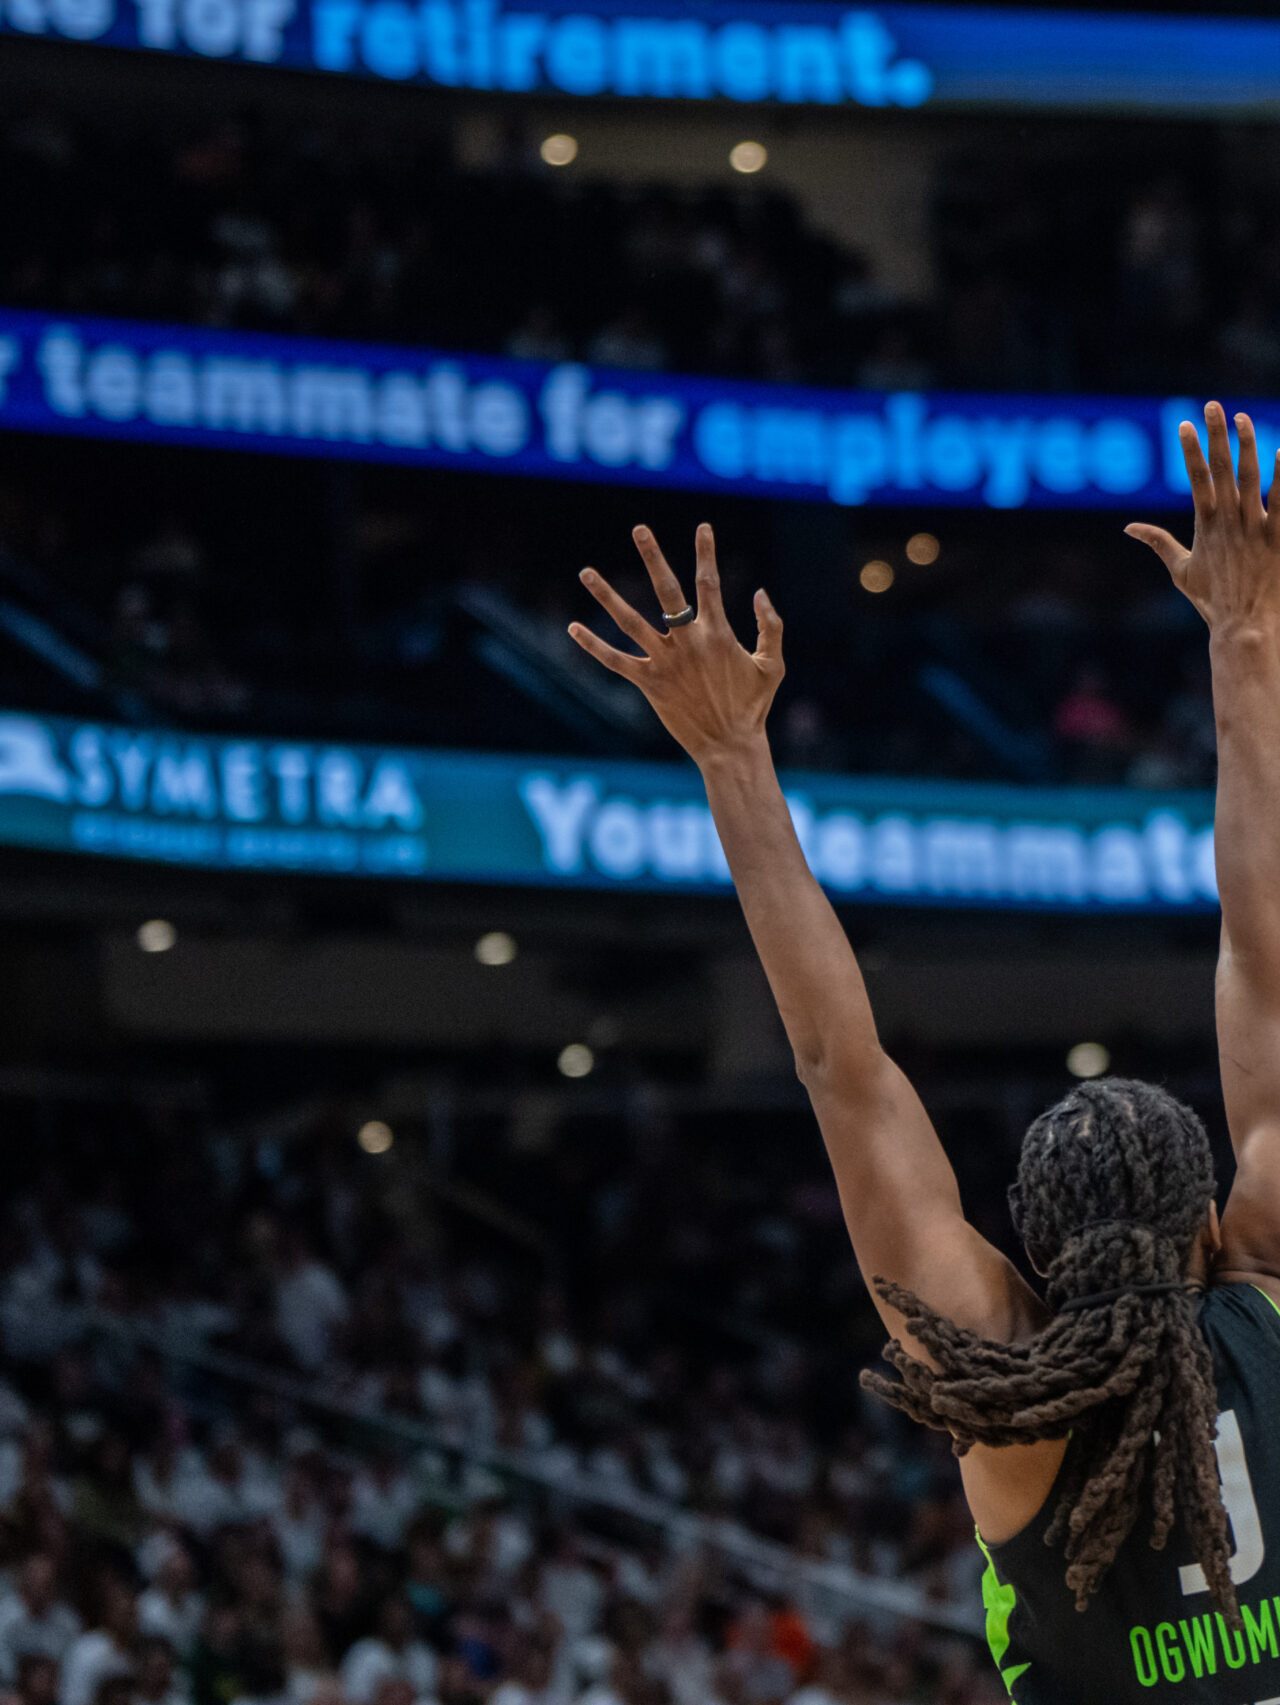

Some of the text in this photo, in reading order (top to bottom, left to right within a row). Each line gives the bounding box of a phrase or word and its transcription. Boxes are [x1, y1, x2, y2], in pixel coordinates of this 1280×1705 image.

[311, 0, 934, 108] retirement.
[37, 323, 529, 458] teammate
[540, 361, 682, 471] for
[694, 393, 1152, 508] employee
[70, 722, 425, 831] SYMETRA
